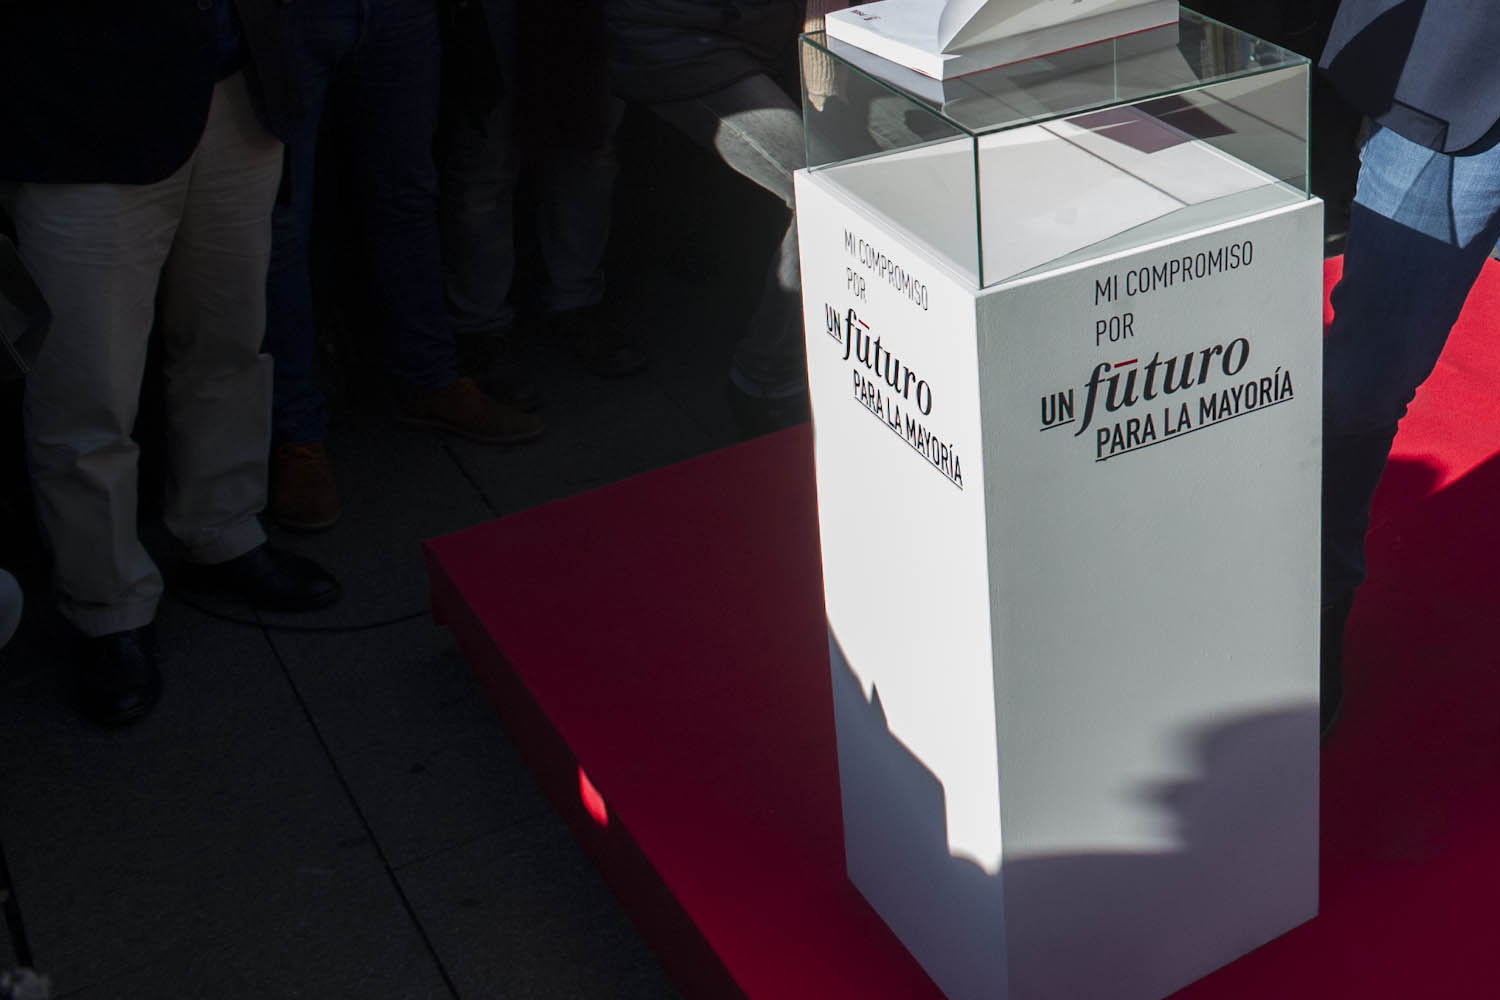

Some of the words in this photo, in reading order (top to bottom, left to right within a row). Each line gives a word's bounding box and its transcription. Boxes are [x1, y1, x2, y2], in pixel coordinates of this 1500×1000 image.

[845, 228, 856, 254] MI
[859, 239, 929, 311] COMPROMISO
[846, 267, 867, 303] POR
[1095, 275, 1118, 306] MI
[1126, 241, 1254, 297] COMPROMISO
[825, 303, 842, 341] UN
[1096, 313, 1134, 346] POR
[854, 369, 884, 420] PARA
[887, 399, 902, 436] LA
[906, 412, 963, 488] MAYORÍA
[1041, 388, 1075, 427] UN
[1097, 413, 1157, 459] PARA
[1164, 402, 1192, 437] LA
[1199, 366, 1294, 426] MAYORÍA
